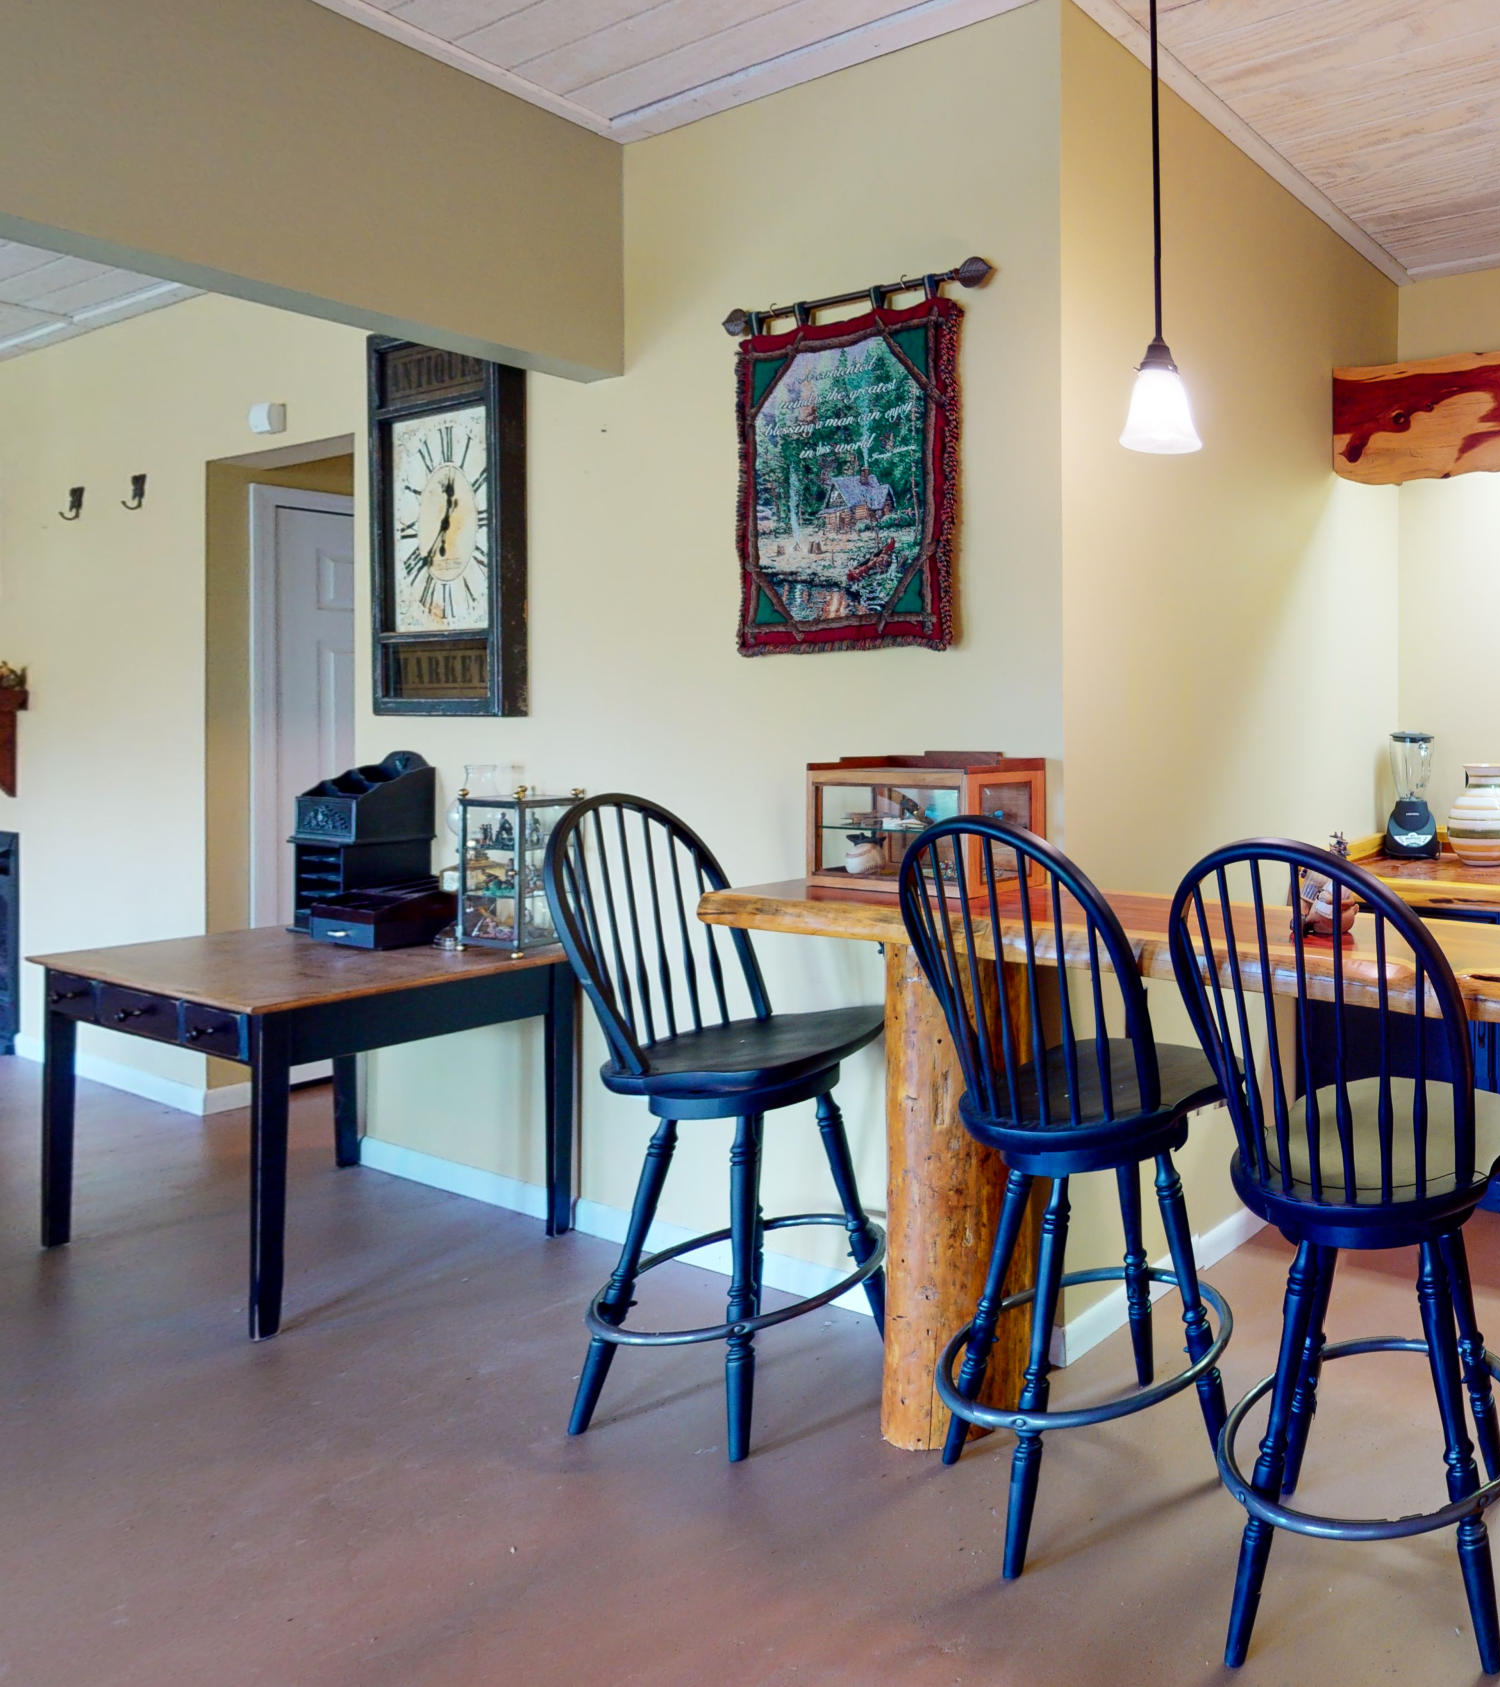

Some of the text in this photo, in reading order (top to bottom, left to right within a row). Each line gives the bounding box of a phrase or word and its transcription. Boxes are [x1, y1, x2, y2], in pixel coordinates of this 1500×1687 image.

[826, 387, 847, 402] the
[844, 378, 898, 405] greatest
[765, 423, 816, 438] blessing
[824, 415, 856, 427] man
[857, 411, 880, 422] can
[884, 401, 914, 422] enjoy
[799, 447, 815, 459] in
[834, 432, 876, 453] world
